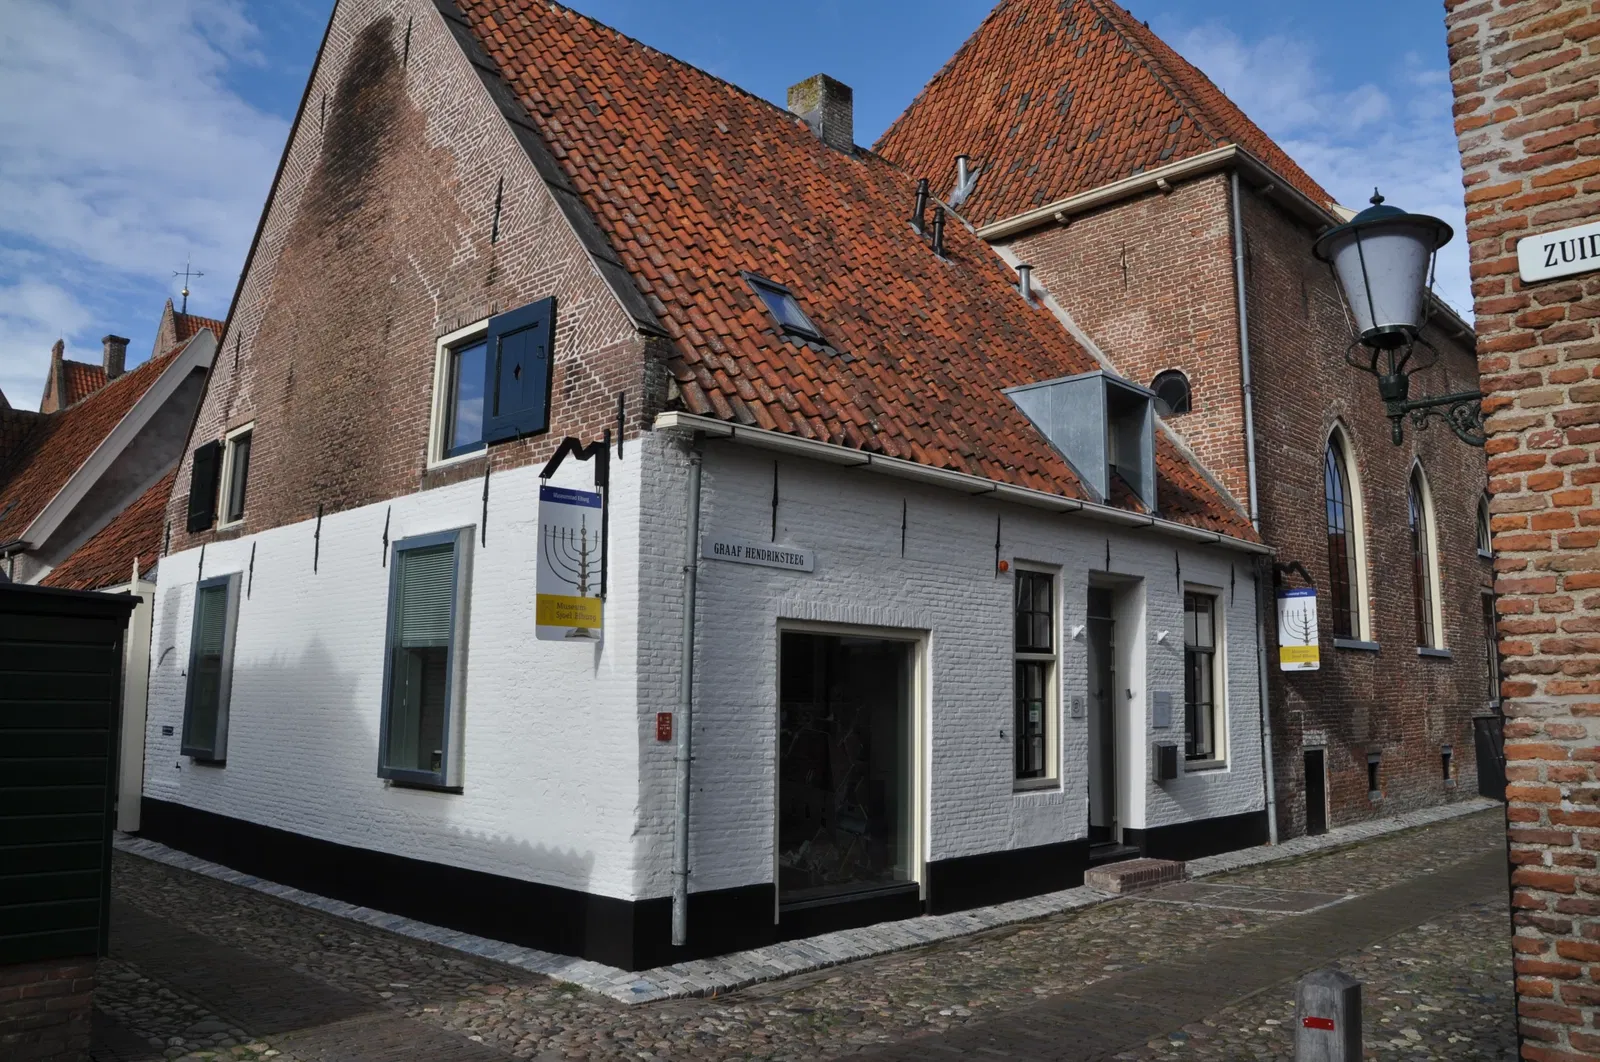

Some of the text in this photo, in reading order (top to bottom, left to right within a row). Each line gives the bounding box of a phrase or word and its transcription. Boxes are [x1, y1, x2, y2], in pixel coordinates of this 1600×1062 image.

[713, 542, 804, 566] GRAAF HENDRIKSTEEG
[556, 602, 586, 611] Museum
